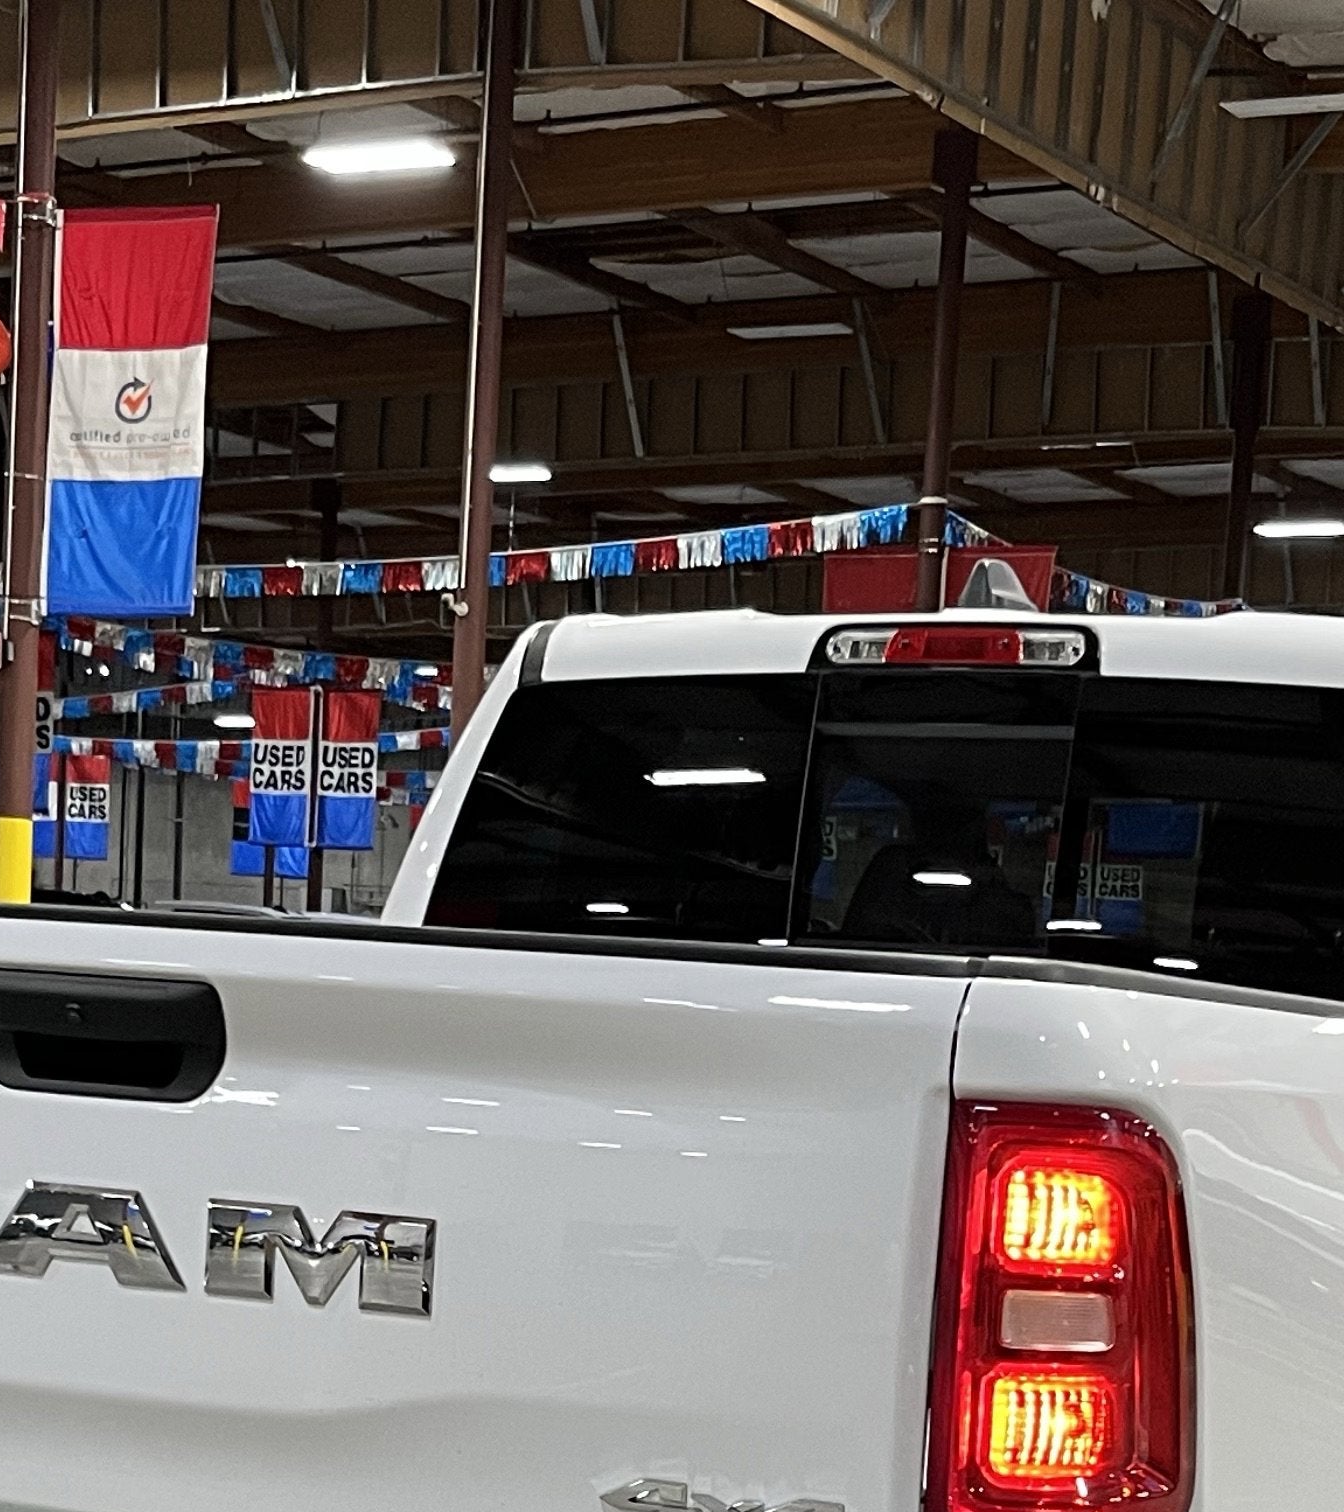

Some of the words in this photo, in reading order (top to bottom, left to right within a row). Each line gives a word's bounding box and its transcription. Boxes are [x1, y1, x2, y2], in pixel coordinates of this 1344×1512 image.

[253, 742, 305, 767] USED
[322, 745, 374, 768] USED
[253, 767, 305, 790] CARS
[320, 770, 373, 793] CARS
[70, 786, 106, 801] USED
[68, 803, 106, 820] CARS
[1100, 866, 1141, 882] USED
[1098, 883, 1140, 898] CARS
